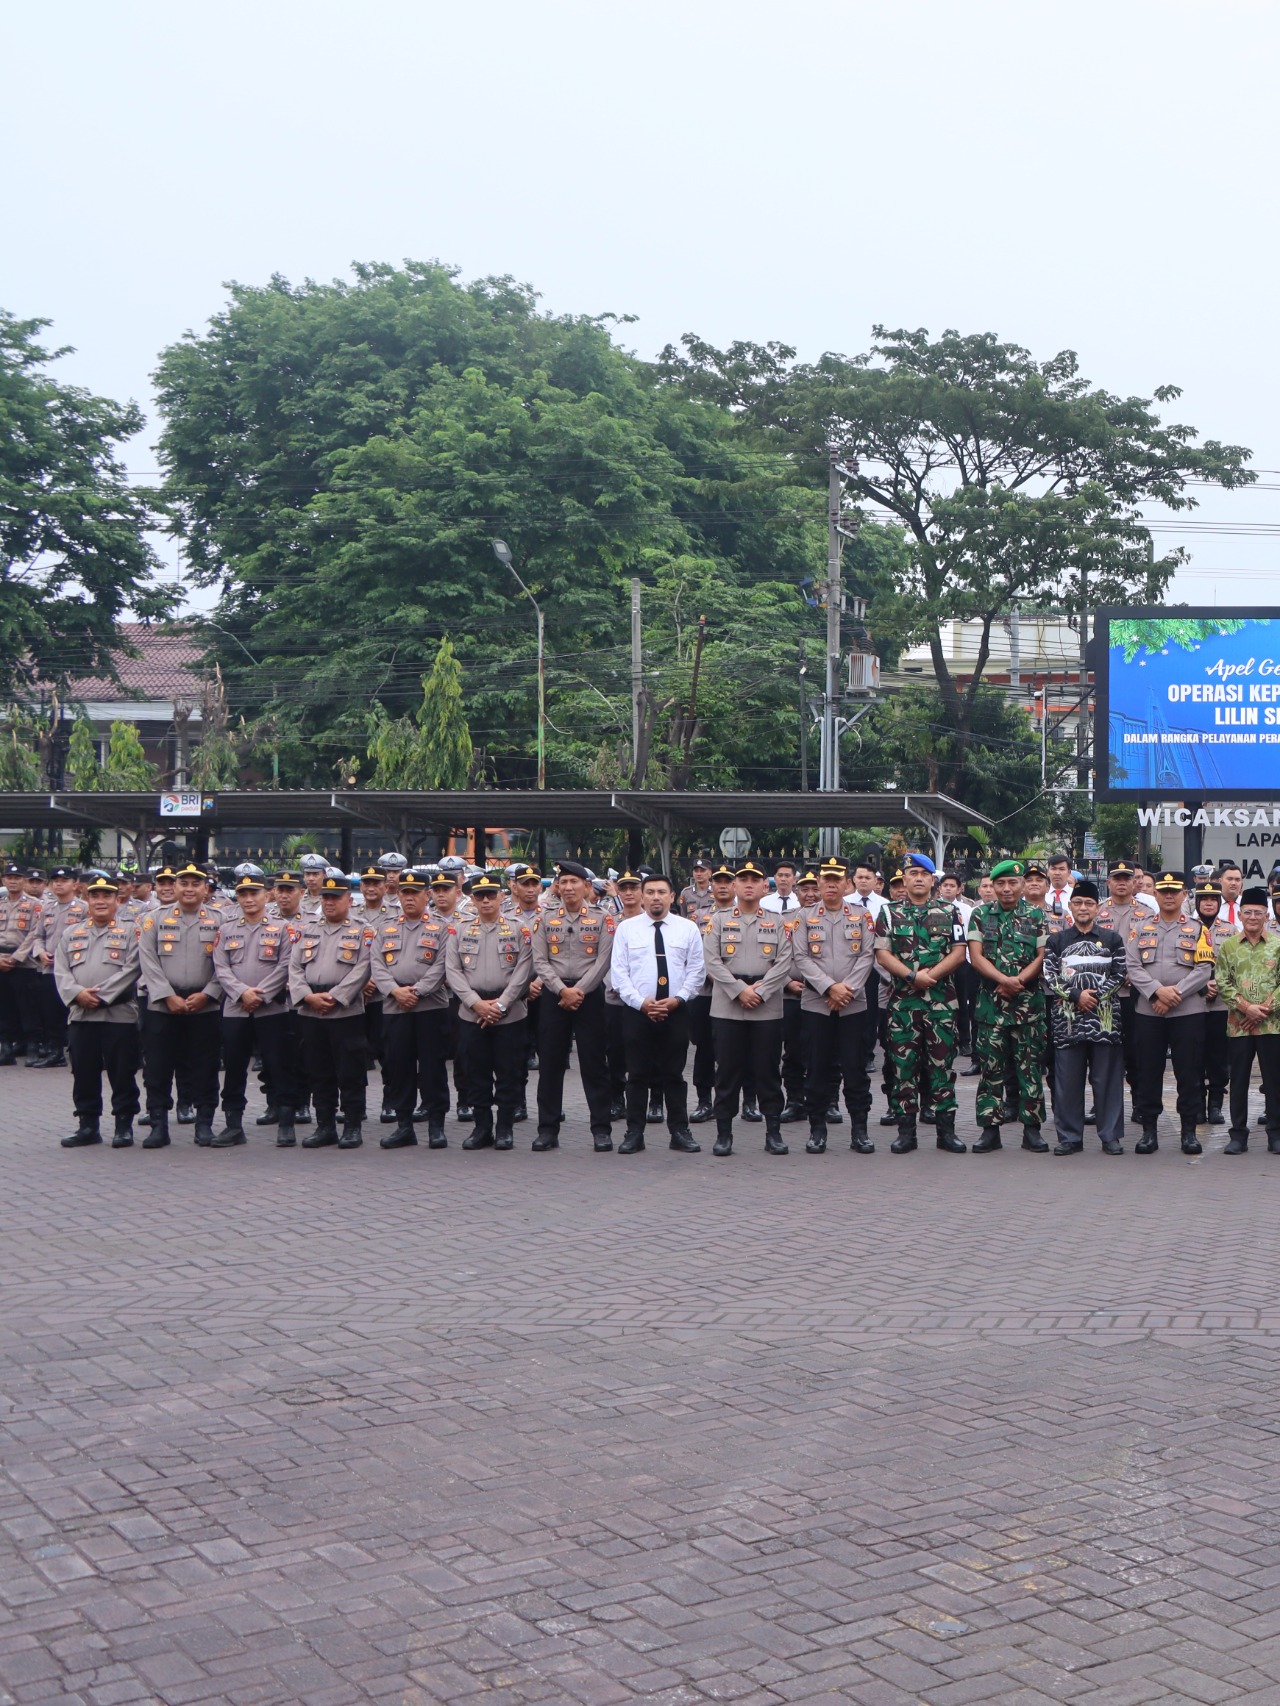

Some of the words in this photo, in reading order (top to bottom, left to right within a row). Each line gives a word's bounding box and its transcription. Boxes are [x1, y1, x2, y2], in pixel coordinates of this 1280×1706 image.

[1207, 657, 1255, 682] Apel
[1168, 684, 1243, 702] OPERASI
[1215, 707, 1258, 725] LILIN
[1123, 733, 1158, 744] DALAM
[1161, 733, 1200, 744] RANGKA
[1202, 733, 1257, 744] PELAYANAN
[181, 794, 199, 805] BRI
